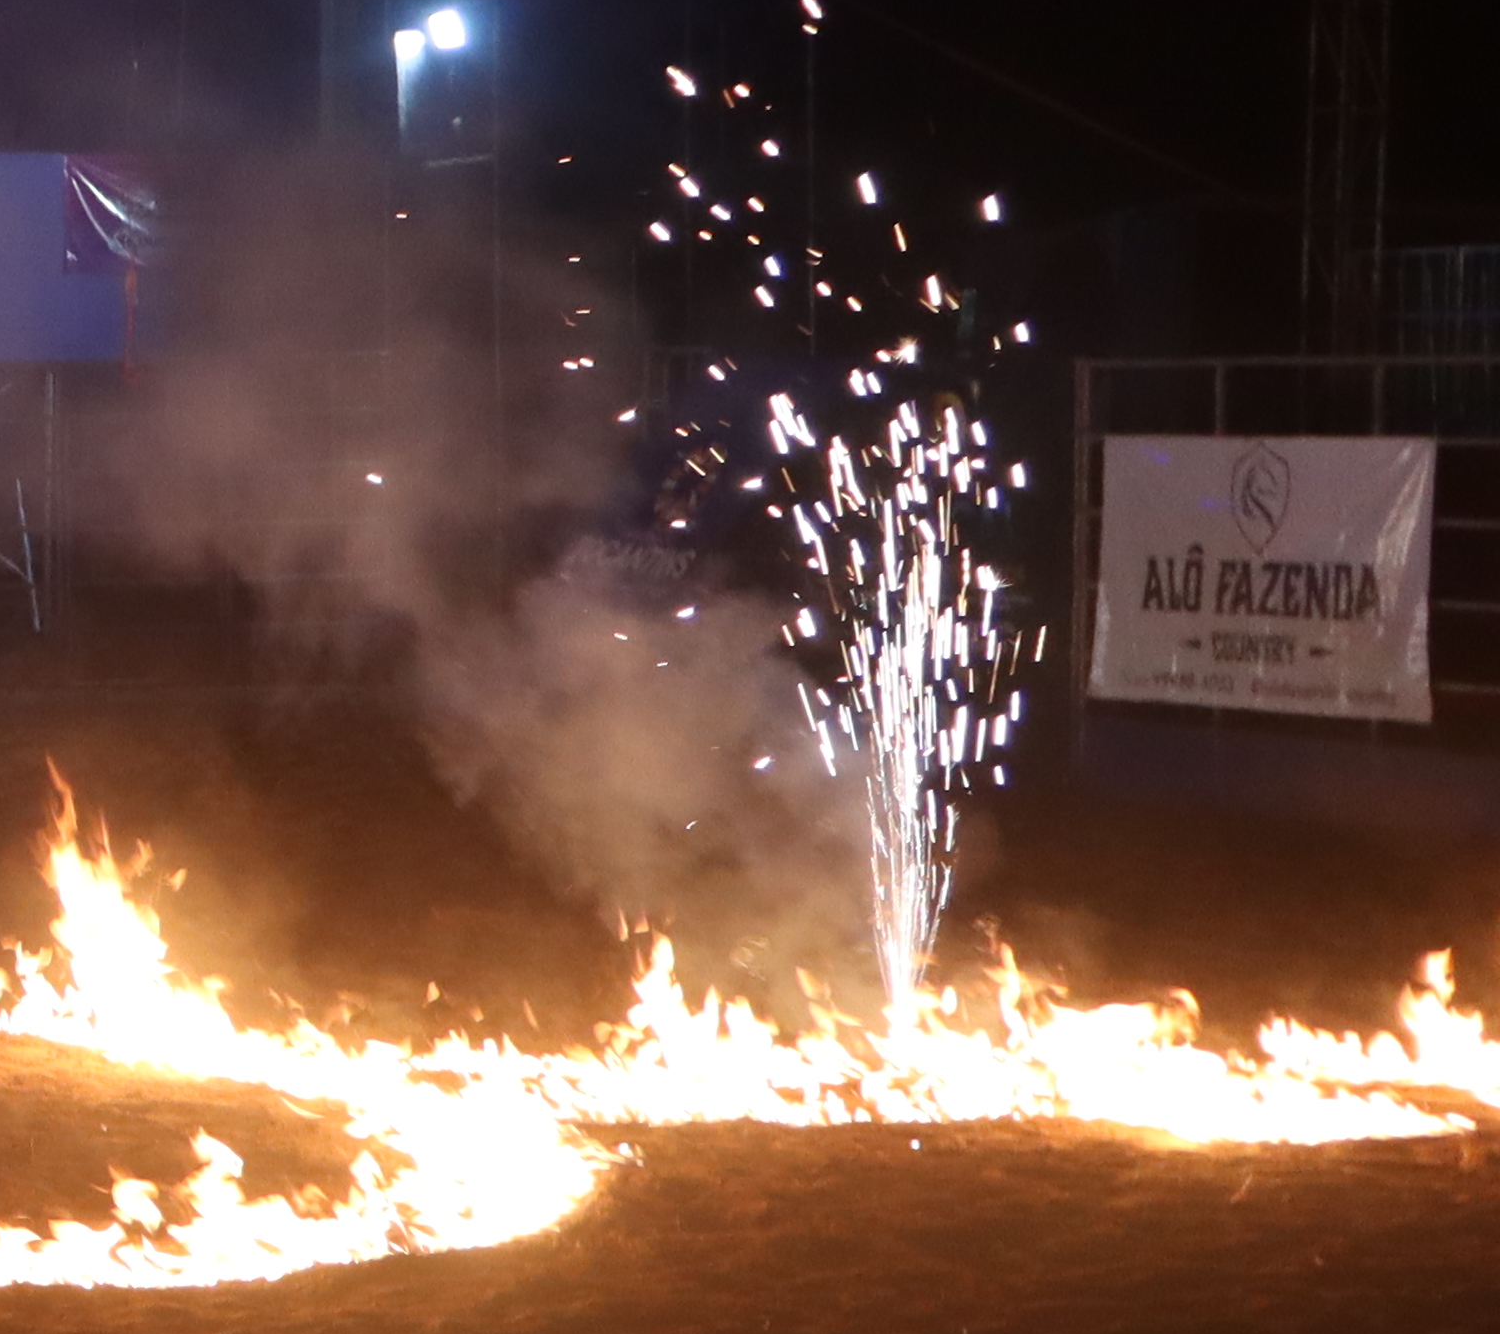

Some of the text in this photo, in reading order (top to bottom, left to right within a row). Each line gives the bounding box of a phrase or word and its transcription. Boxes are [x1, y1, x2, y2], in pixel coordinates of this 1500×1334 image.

[1142, 542, 1380, 622] ALÔ FAZENDA
[1211, 631, 1295, 664] COUNTRY
